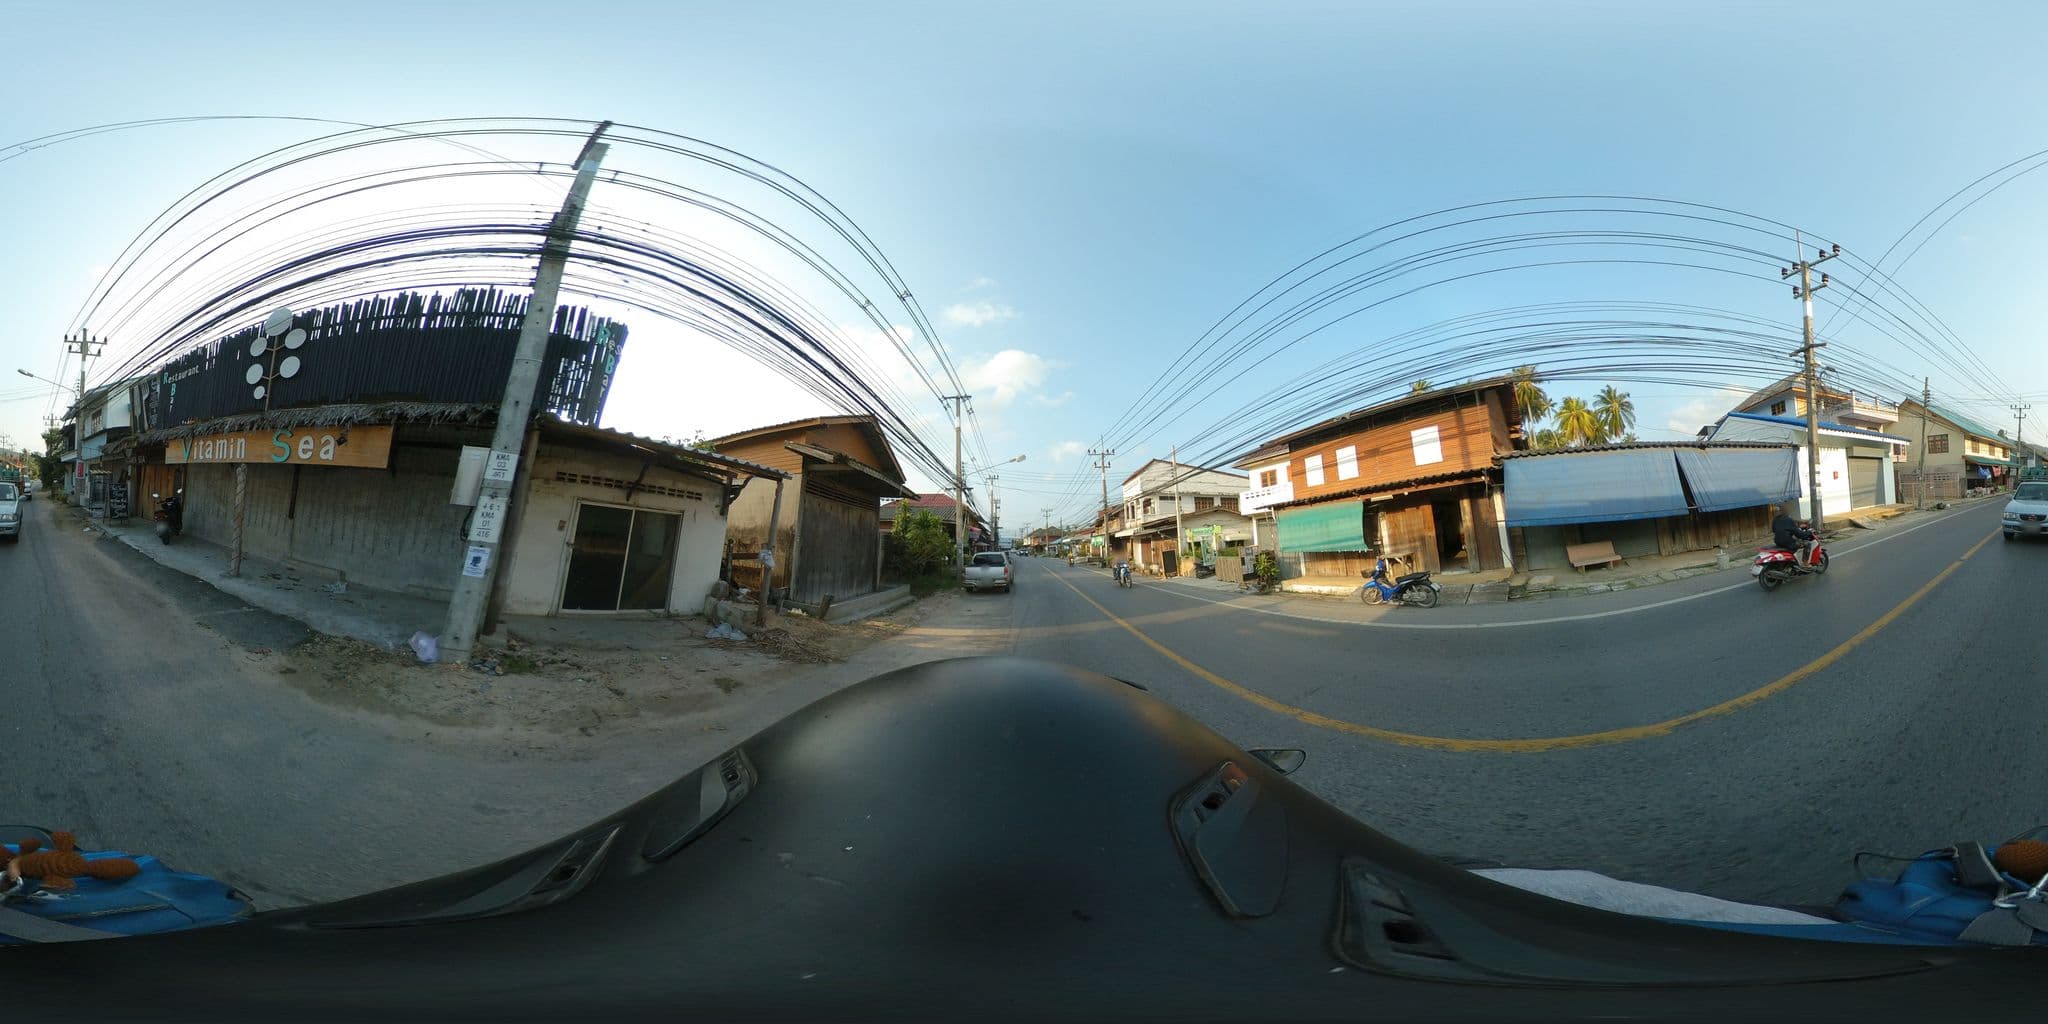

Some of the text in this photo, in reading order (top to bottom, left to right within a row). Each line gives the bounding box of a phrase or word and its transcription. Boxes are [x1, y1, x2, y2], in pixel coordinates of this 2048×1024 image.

[163, 365, 199, 384] Restaurant
[599, 355, 615, 398] Bar
[169, 383, 177, 412] Bar
[181, 428, 336, 463] Vitamin Sea
